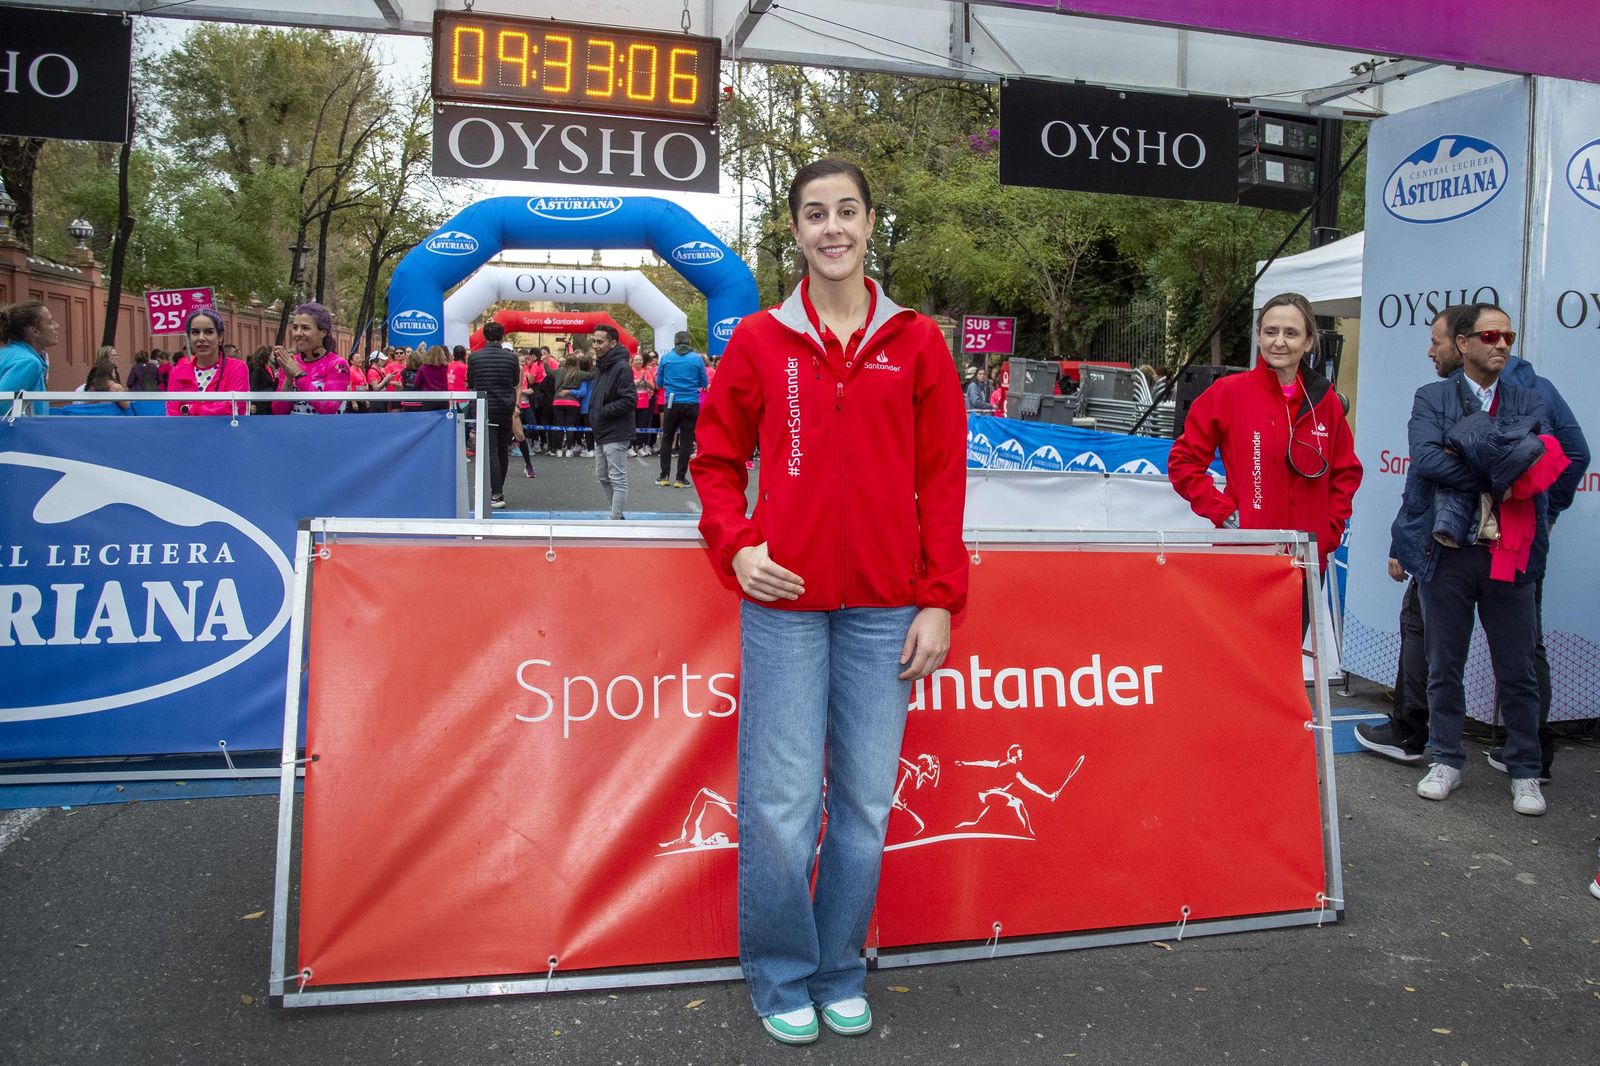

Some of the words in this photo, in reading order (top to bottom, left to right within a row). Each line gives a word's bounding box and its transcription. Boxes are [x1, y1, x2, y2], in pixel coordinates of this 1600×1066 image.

[453, 26, 698, 104] 09:33:06
[448, 117, 706, 181] OYSHO
[1041, 120, 1207, 169] OYSHO
[1410, 165, 1448, 180] CENTRAL
[1452, 156, 1494, 171] LECHERA
[1576, 158, 1600, 192] A
[1391, 168, 1498, 208] ASTURIANA
[534, 198, 615, 210] ASTURIANA
[430, 240, 475, 250] ASTURIANA
[676, 250, 720, 260] ASTURIANA
[515, 274, 611, 296] OYSHO
[150, 293, 183, 307] SUB
[394, 319, 436, 330] ASTURIANA
[523, 317, 543, 325] Sports
[966, 319, 991, 330] SUB
[864, 361, 901, 372] Santander
[784, 357, 803, 477] #SportSantander
[1252, 430, 1263, 510] #SportsSantander
[46, 542, 236, 567] LECHERA
[0, 578, 253, 646] RIANA
[514, 658, 737, 739] Sports
